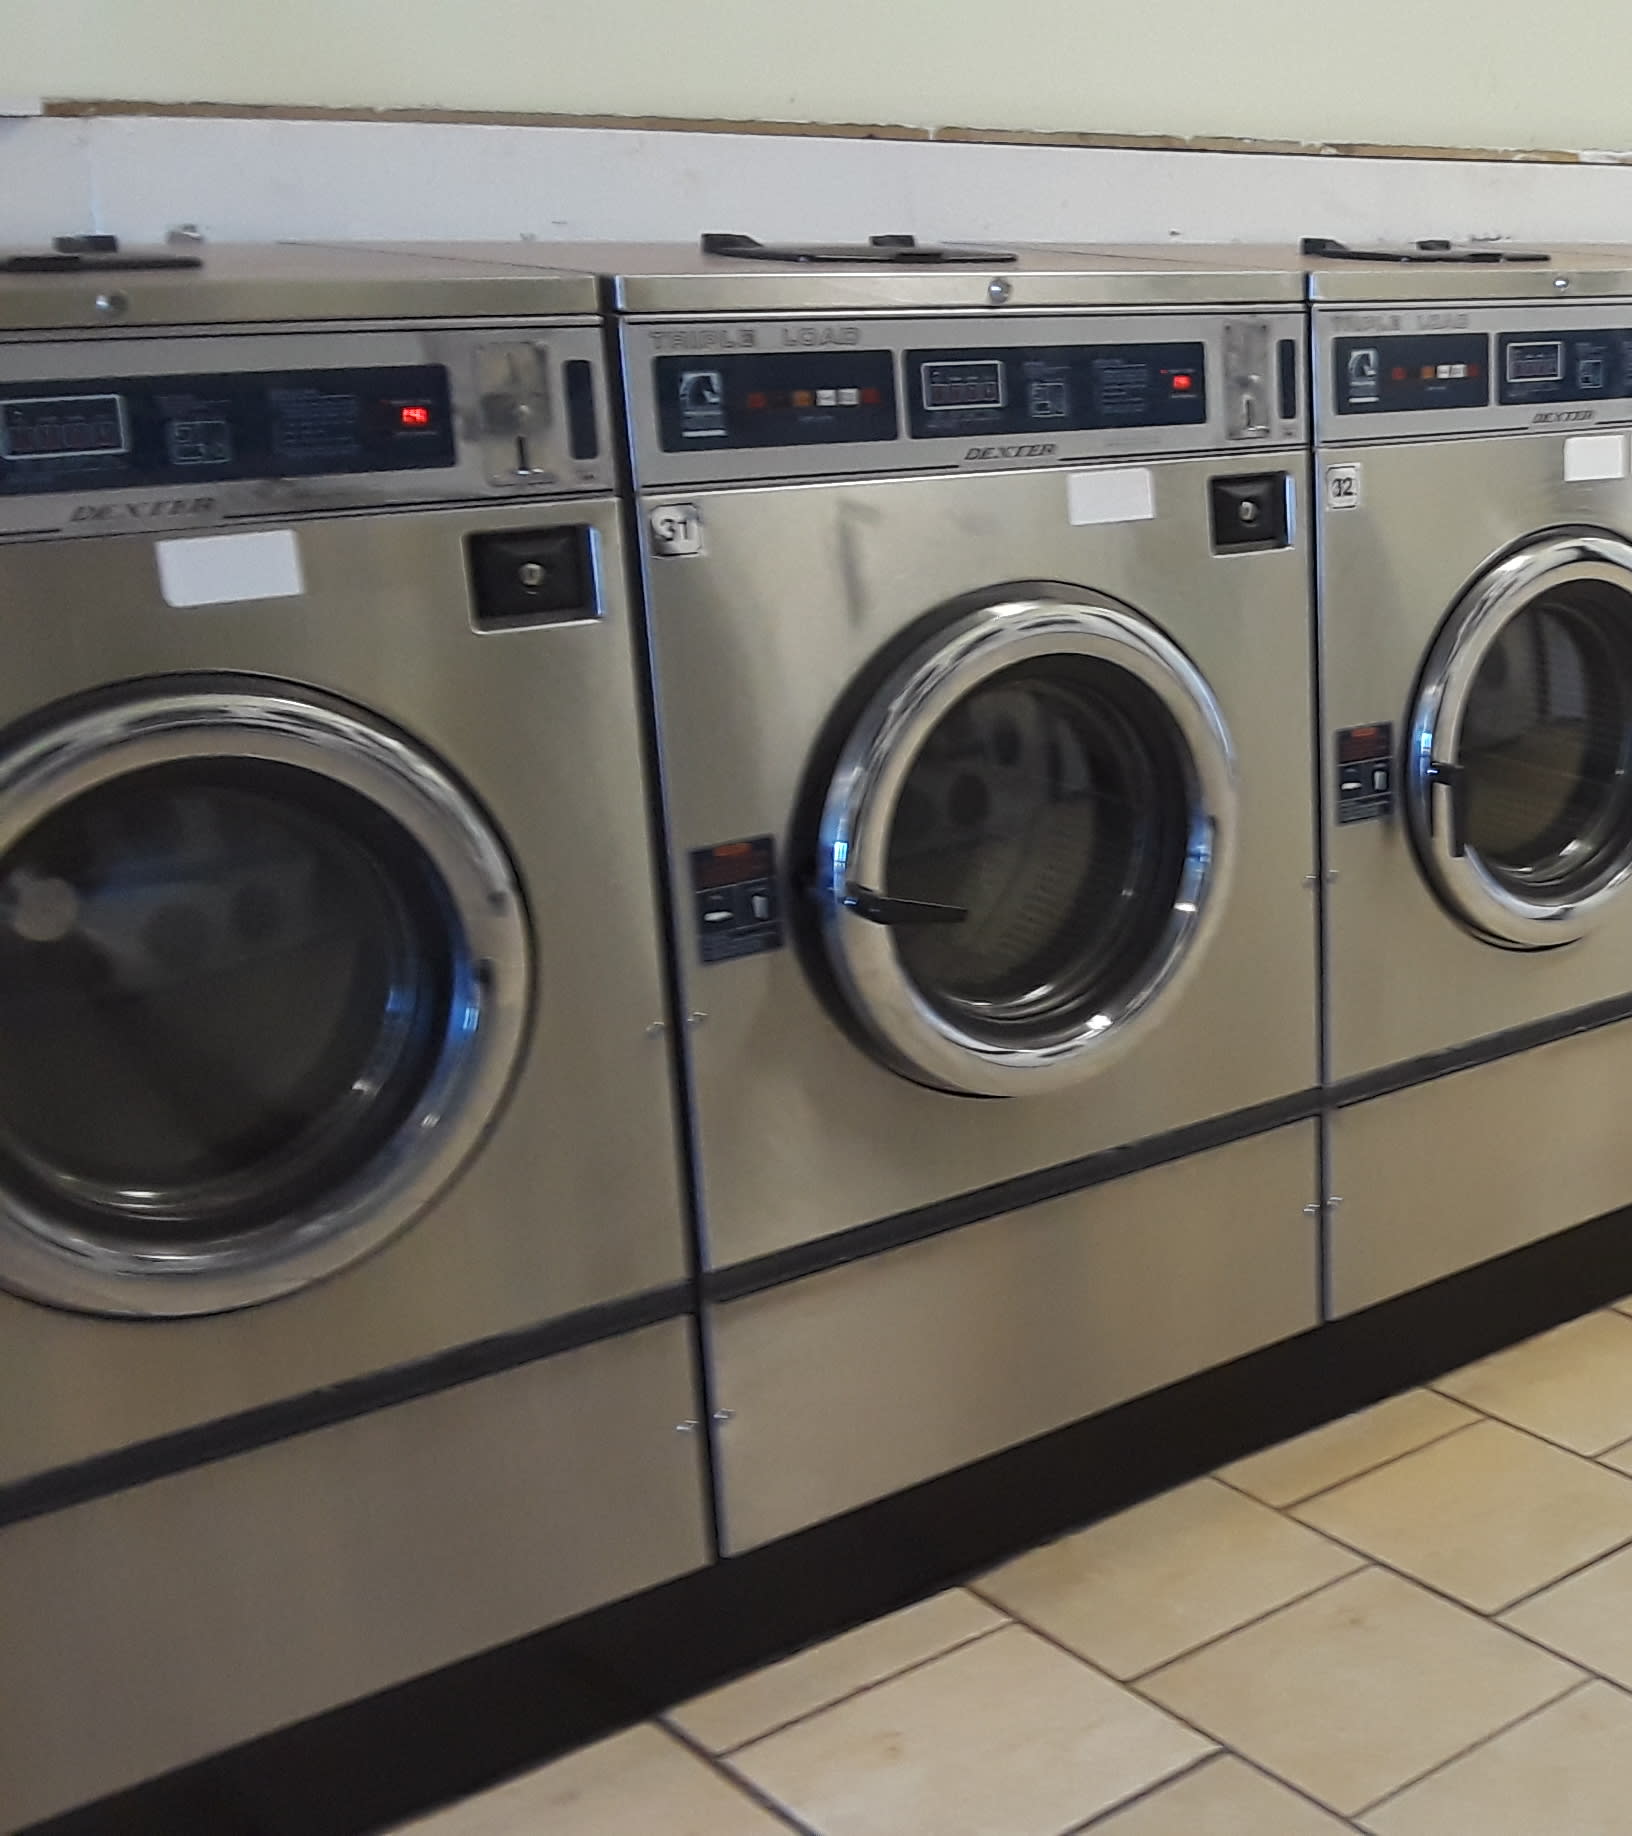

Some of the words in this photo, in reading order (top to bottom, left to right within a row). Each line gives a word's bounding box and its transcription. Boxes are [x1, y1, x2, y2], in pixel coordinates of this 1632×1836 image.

[782, 326, 861, 347] LOAD
[964, 443, 1057, 460] DEXTER
[1331, 476, 1354, 498] 32
[656, 518, 689, 542] 31
